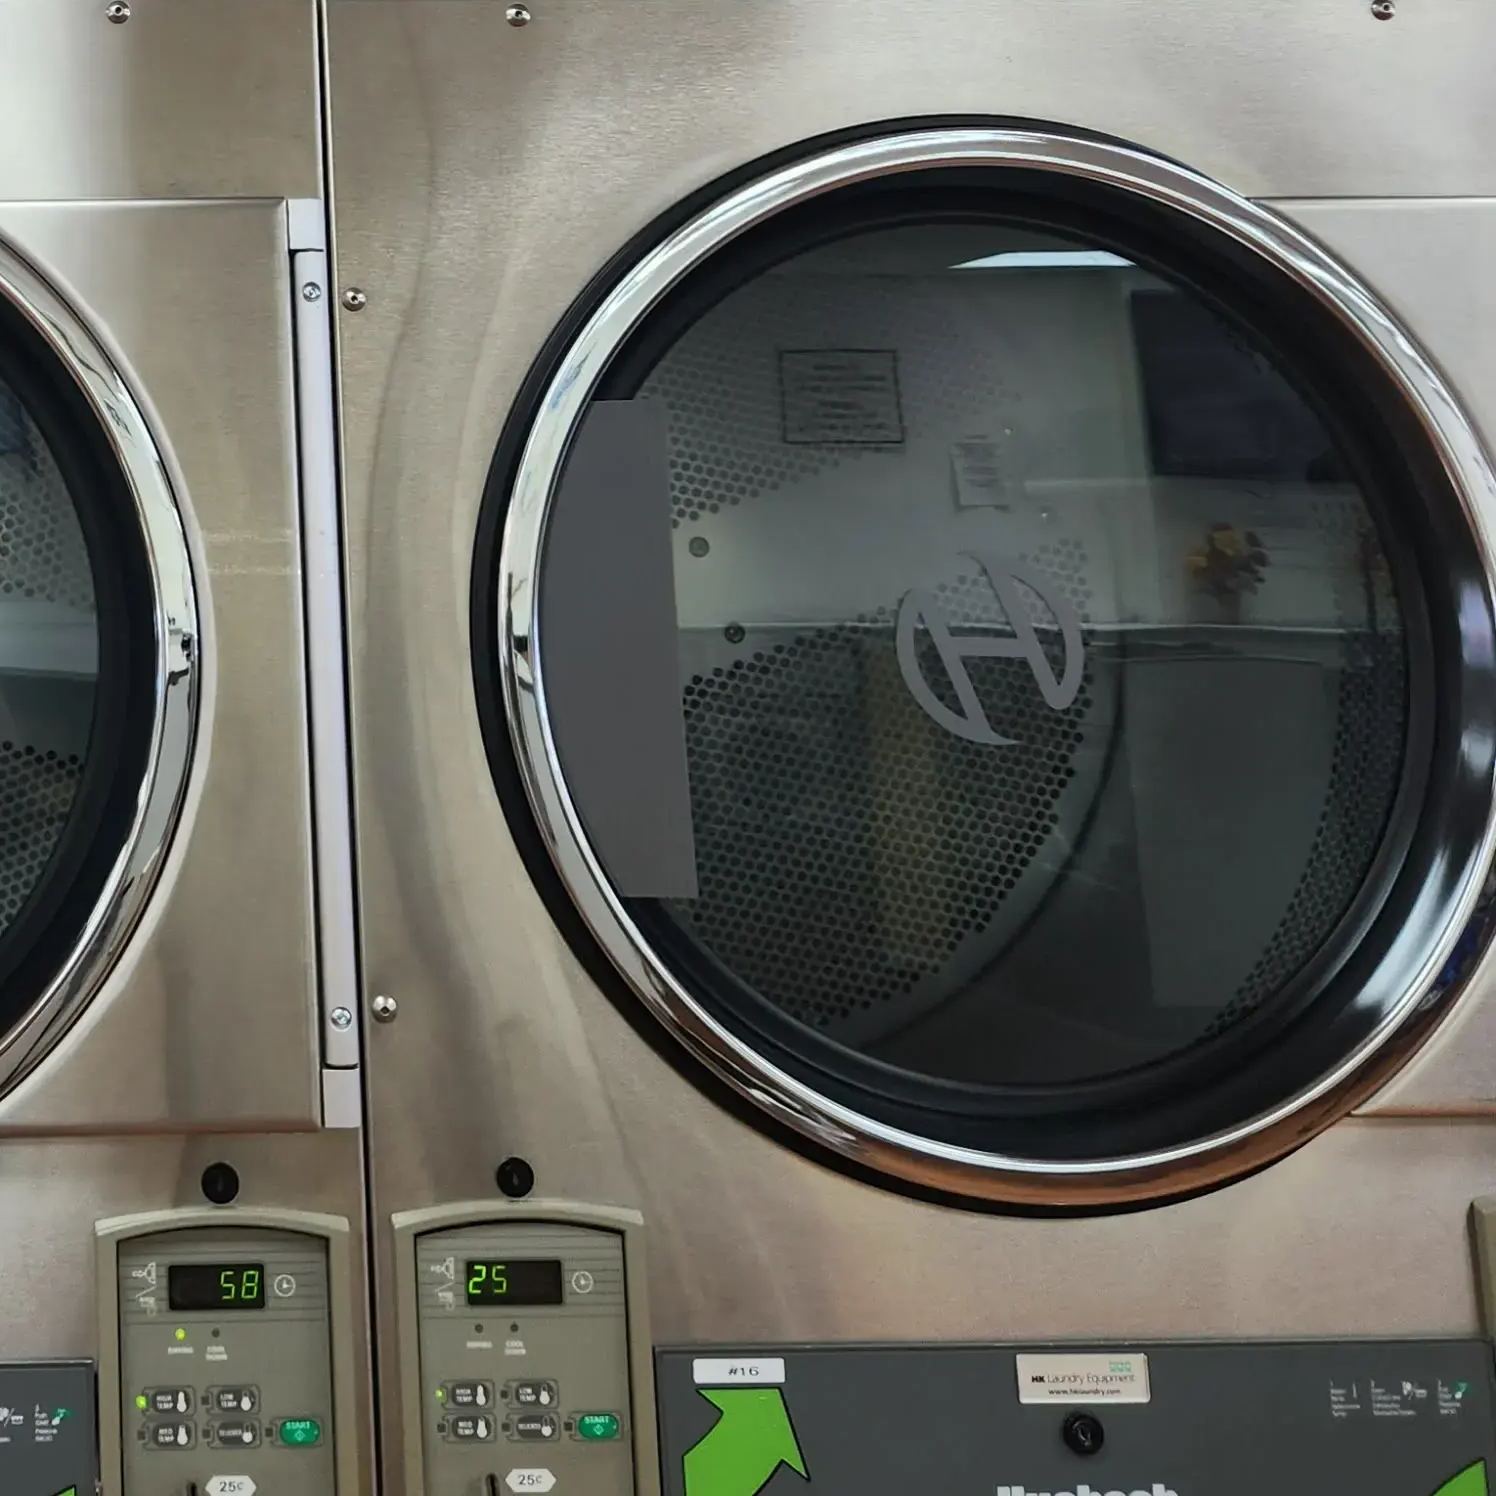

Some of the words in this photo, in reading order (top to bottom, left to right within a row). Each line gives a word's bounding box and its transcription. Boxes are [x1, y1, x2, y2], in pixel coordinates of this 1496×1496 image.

[219, 1269, 260, 1300] 58
[468, 1264, 507, 1294] 25
[728, 1366, 760, 1377] #16
[1047, 1372, 1085, 1385] Laundry
[1086, 1372, 1135, 1385] Equipment
[285, 1421, 311, 1430] START
[584, 1415, 610, 1424] START
